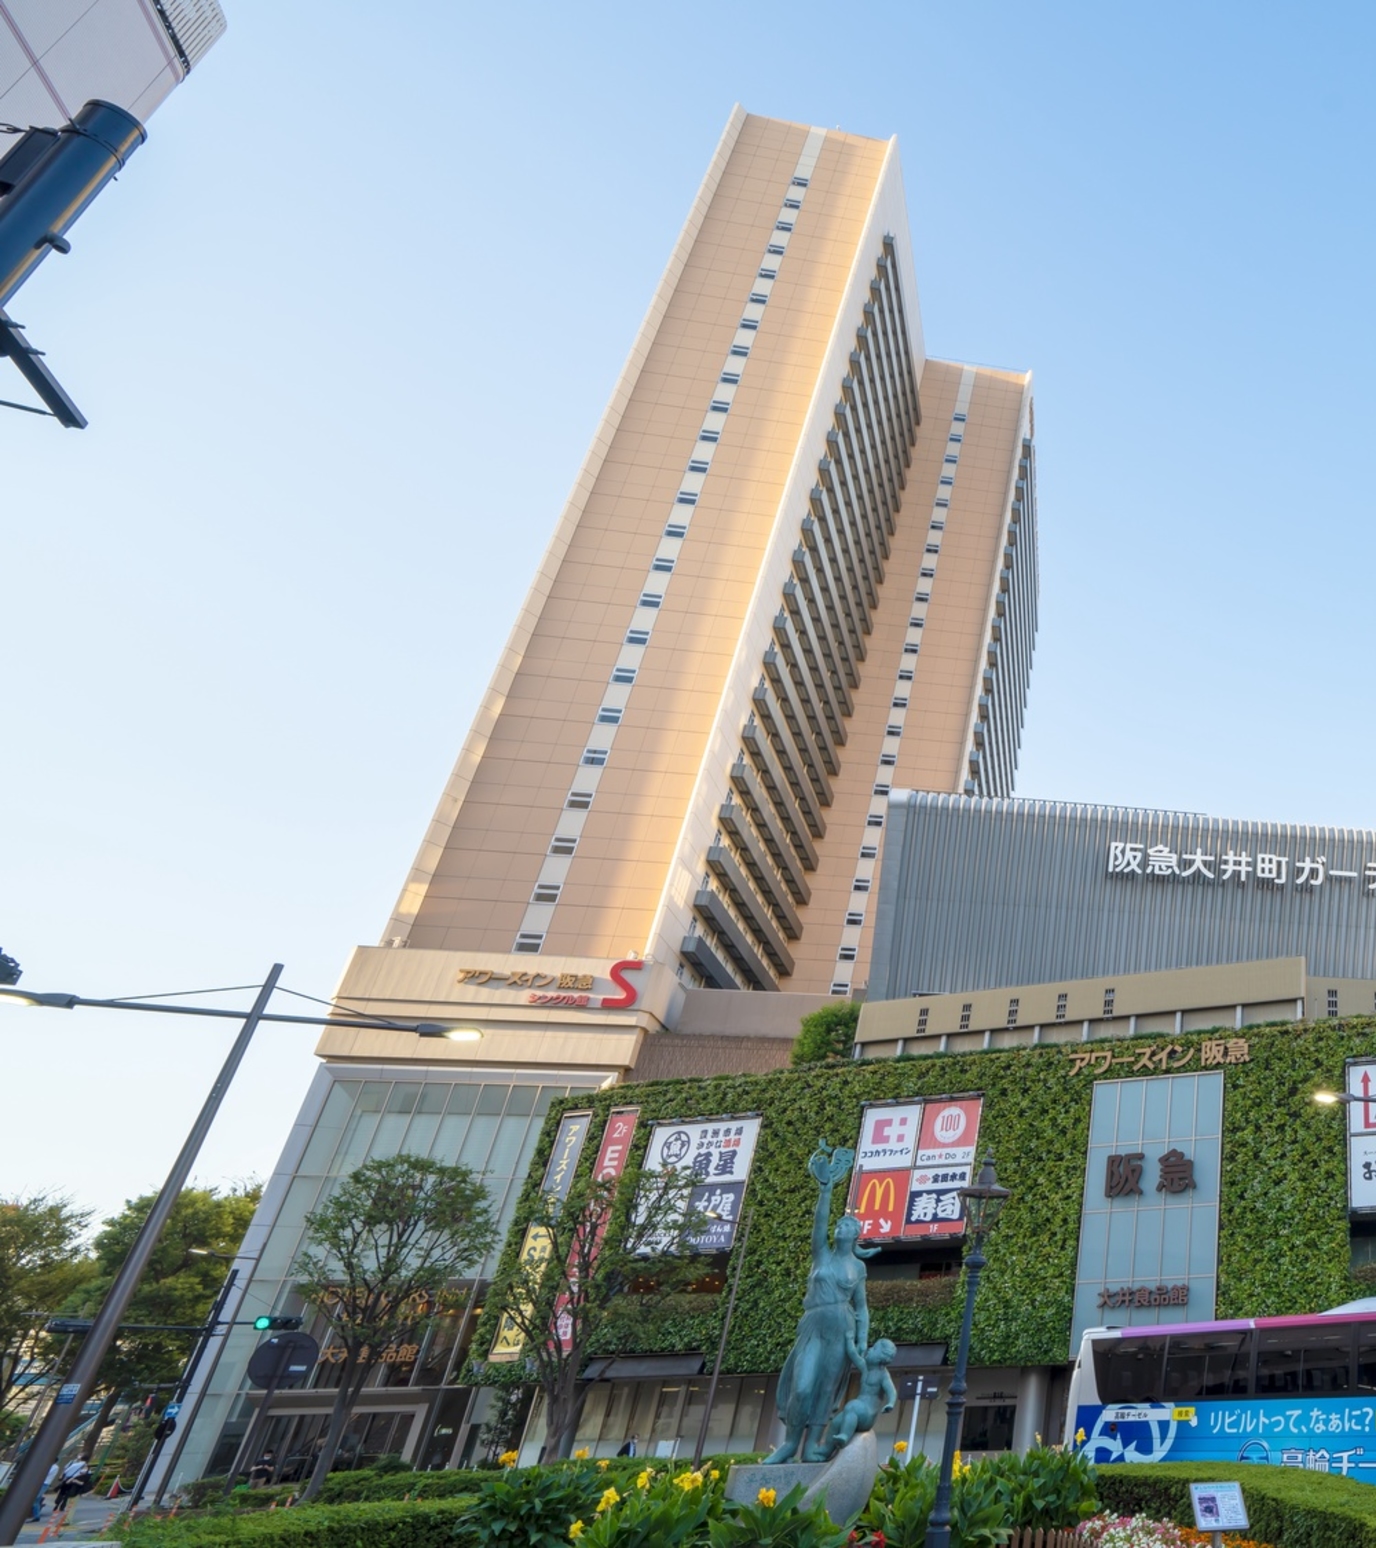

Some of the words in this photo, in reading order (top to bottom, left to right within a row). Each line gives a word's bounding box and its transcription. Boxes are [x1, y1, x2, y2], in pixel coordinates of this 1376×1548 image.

[456, 968, 554, 988] アワーズイン
[556, 972, 594, 990] 阪急
[601, 960, 644, 1007] S
[528, 993, 590, 1006] シングル館
[1068, 1043, 1194, 1076] アワーズイン
[1200, 1038, 1251, 1066] 阪急
[612, 1122, 629, 1138] 2F
[940, 1113, 961, 1132] 100
[861, 1147, 911, 1159] ココカラファイン
[1104, 1148, 1197, 1198] 阪急
[911, 1190, 962, 1222] 寿司
[929, 1224, 939, 1233] 1F
[1097, 1284, 1189, 1308] 大井食品館
